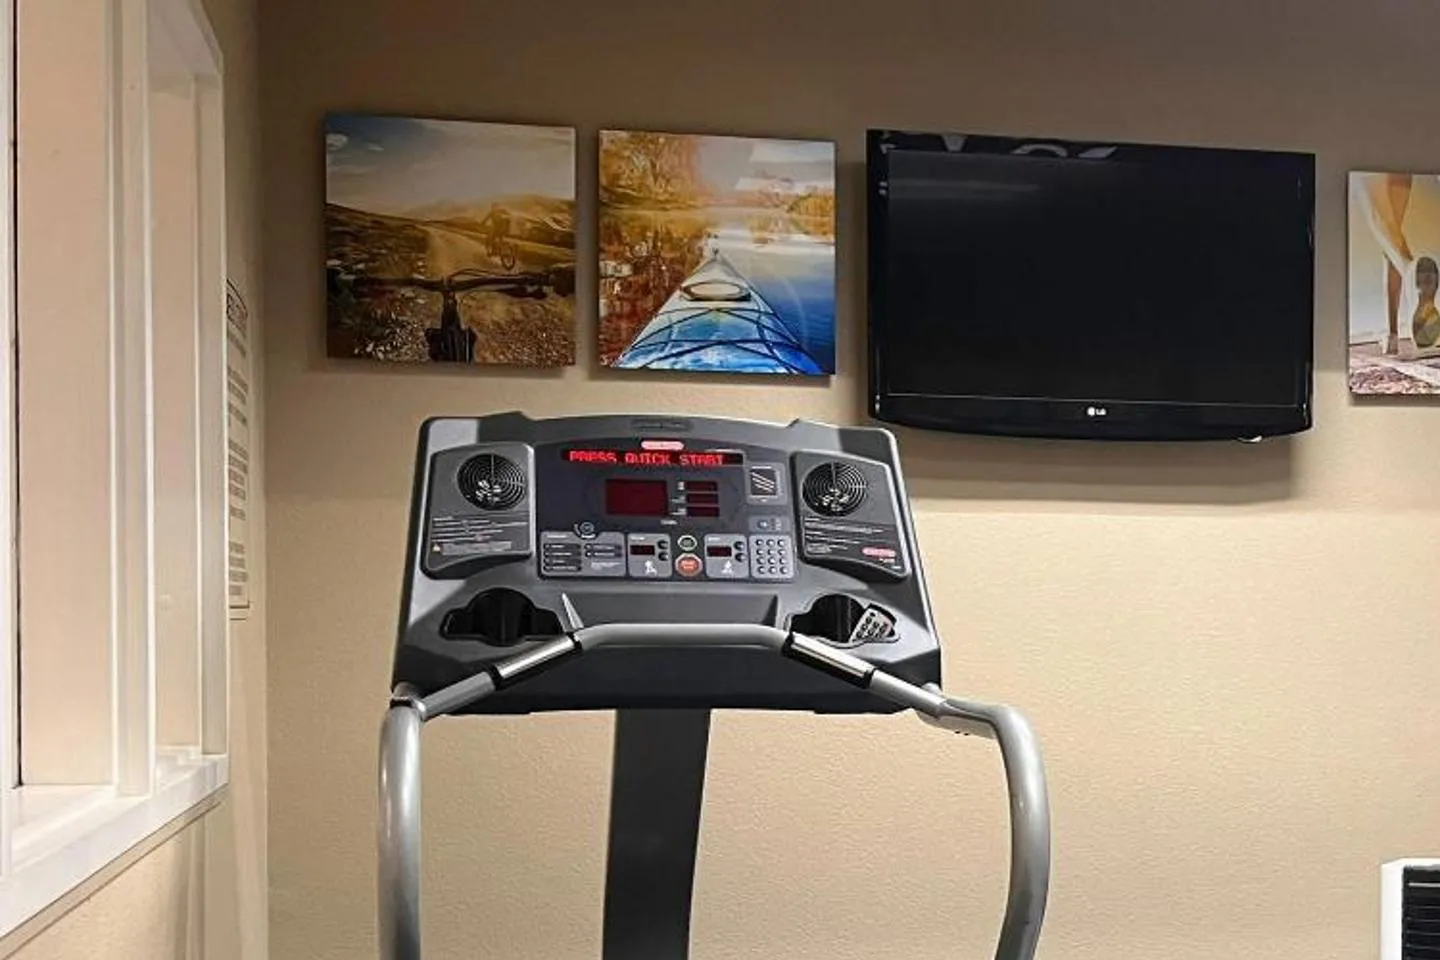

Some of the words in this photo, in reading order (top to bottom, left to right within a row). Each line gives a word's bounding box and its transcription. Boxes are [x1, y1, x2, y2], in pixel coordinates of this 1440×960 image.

[569, 450, 618, 464] PRESS
[625, 451, 671, 466] QUICK
[679, 453, 725, 467] START
